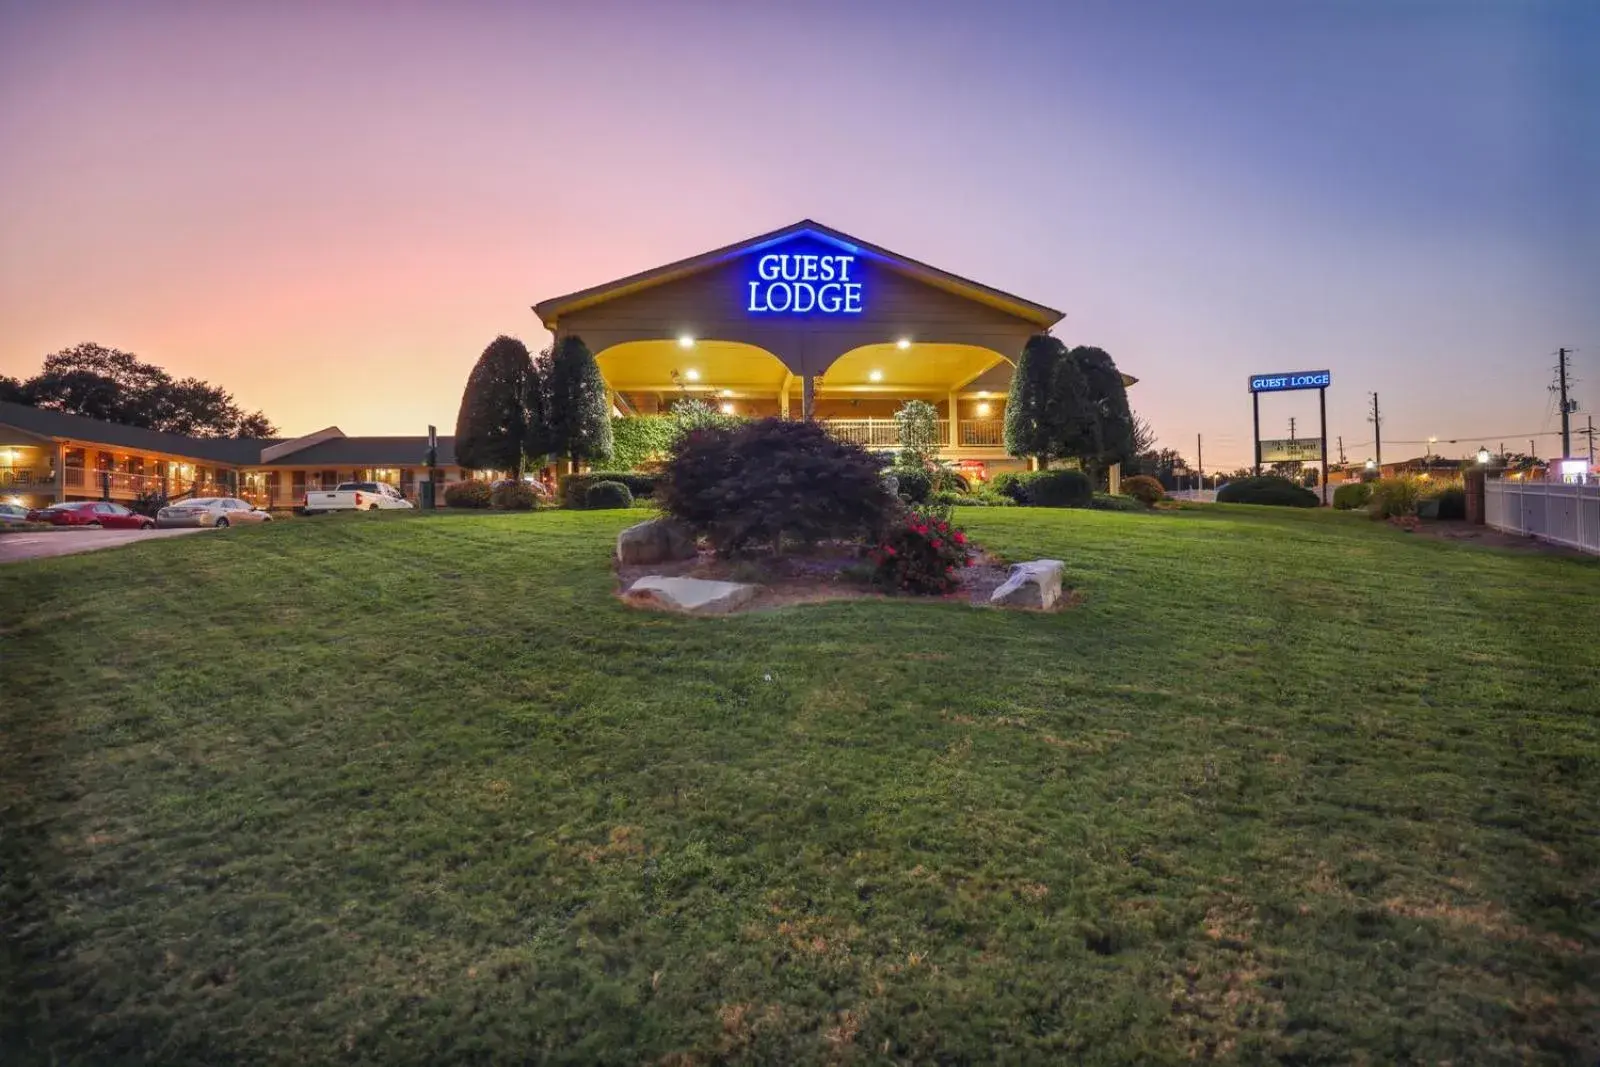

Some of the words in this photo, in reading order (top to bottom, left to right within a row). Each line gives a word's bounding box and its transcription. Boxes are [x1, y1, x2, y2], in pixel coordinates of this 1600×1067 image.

[758, 254, 854, 281] GUEST
[748, 281, 862, 312] LODGE
[1253, 378, 1287, 388] GUEST
[1291, 375, 1329, 385] LODGE
